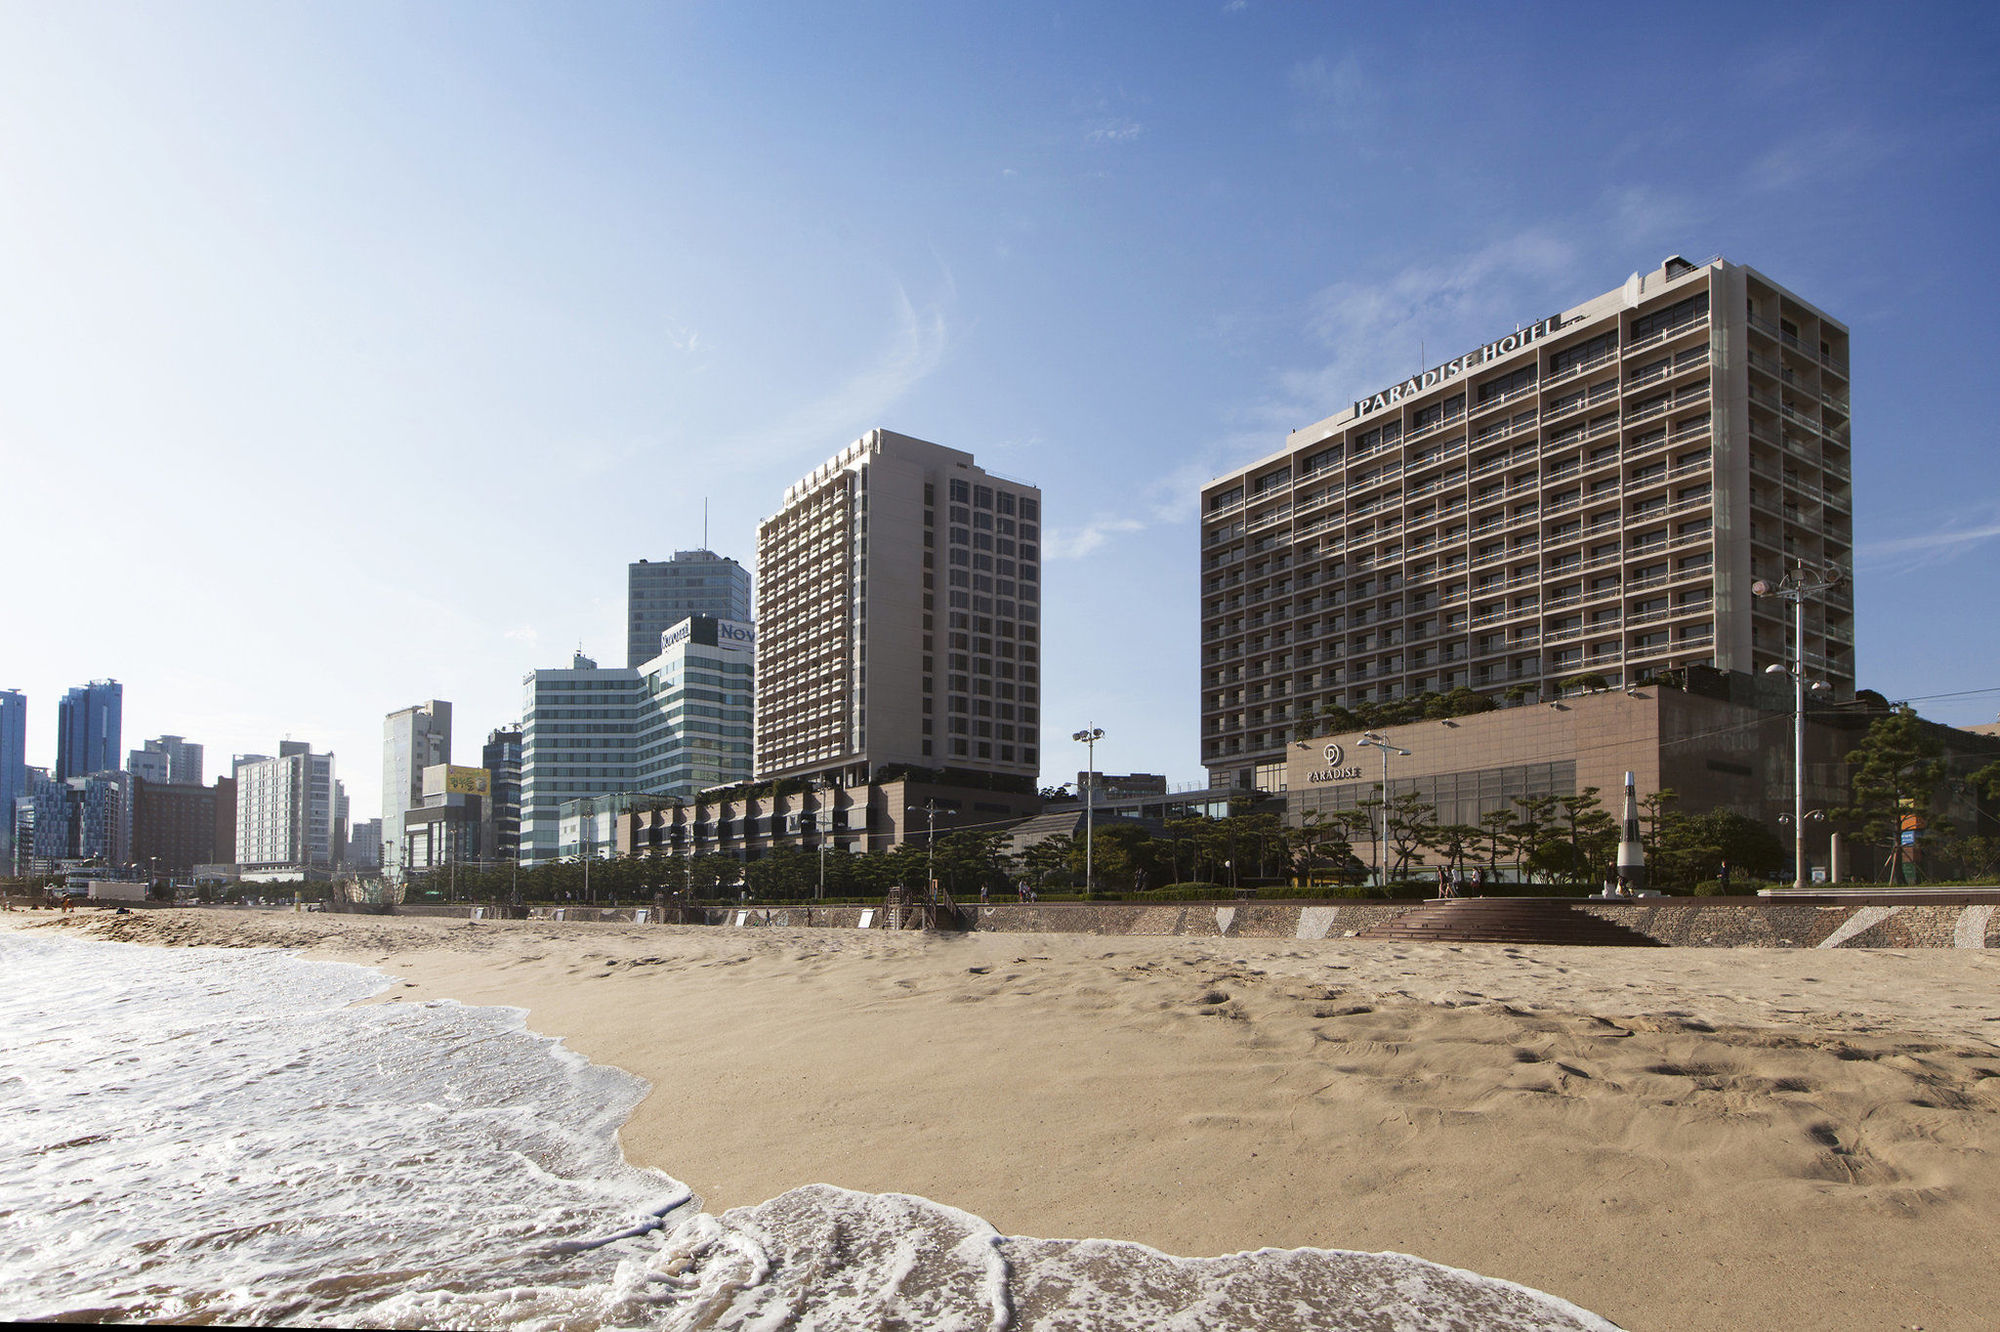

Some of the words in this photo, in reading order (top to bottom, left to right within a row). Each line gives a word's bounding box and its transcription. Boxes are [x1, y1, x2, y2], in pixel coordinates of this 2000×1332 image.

[1358, 353, 1473, 418] PARADISE
[1482, 319, 1554, 363] HOTEL
[1307, 767, 1358, 782] PARADISE
